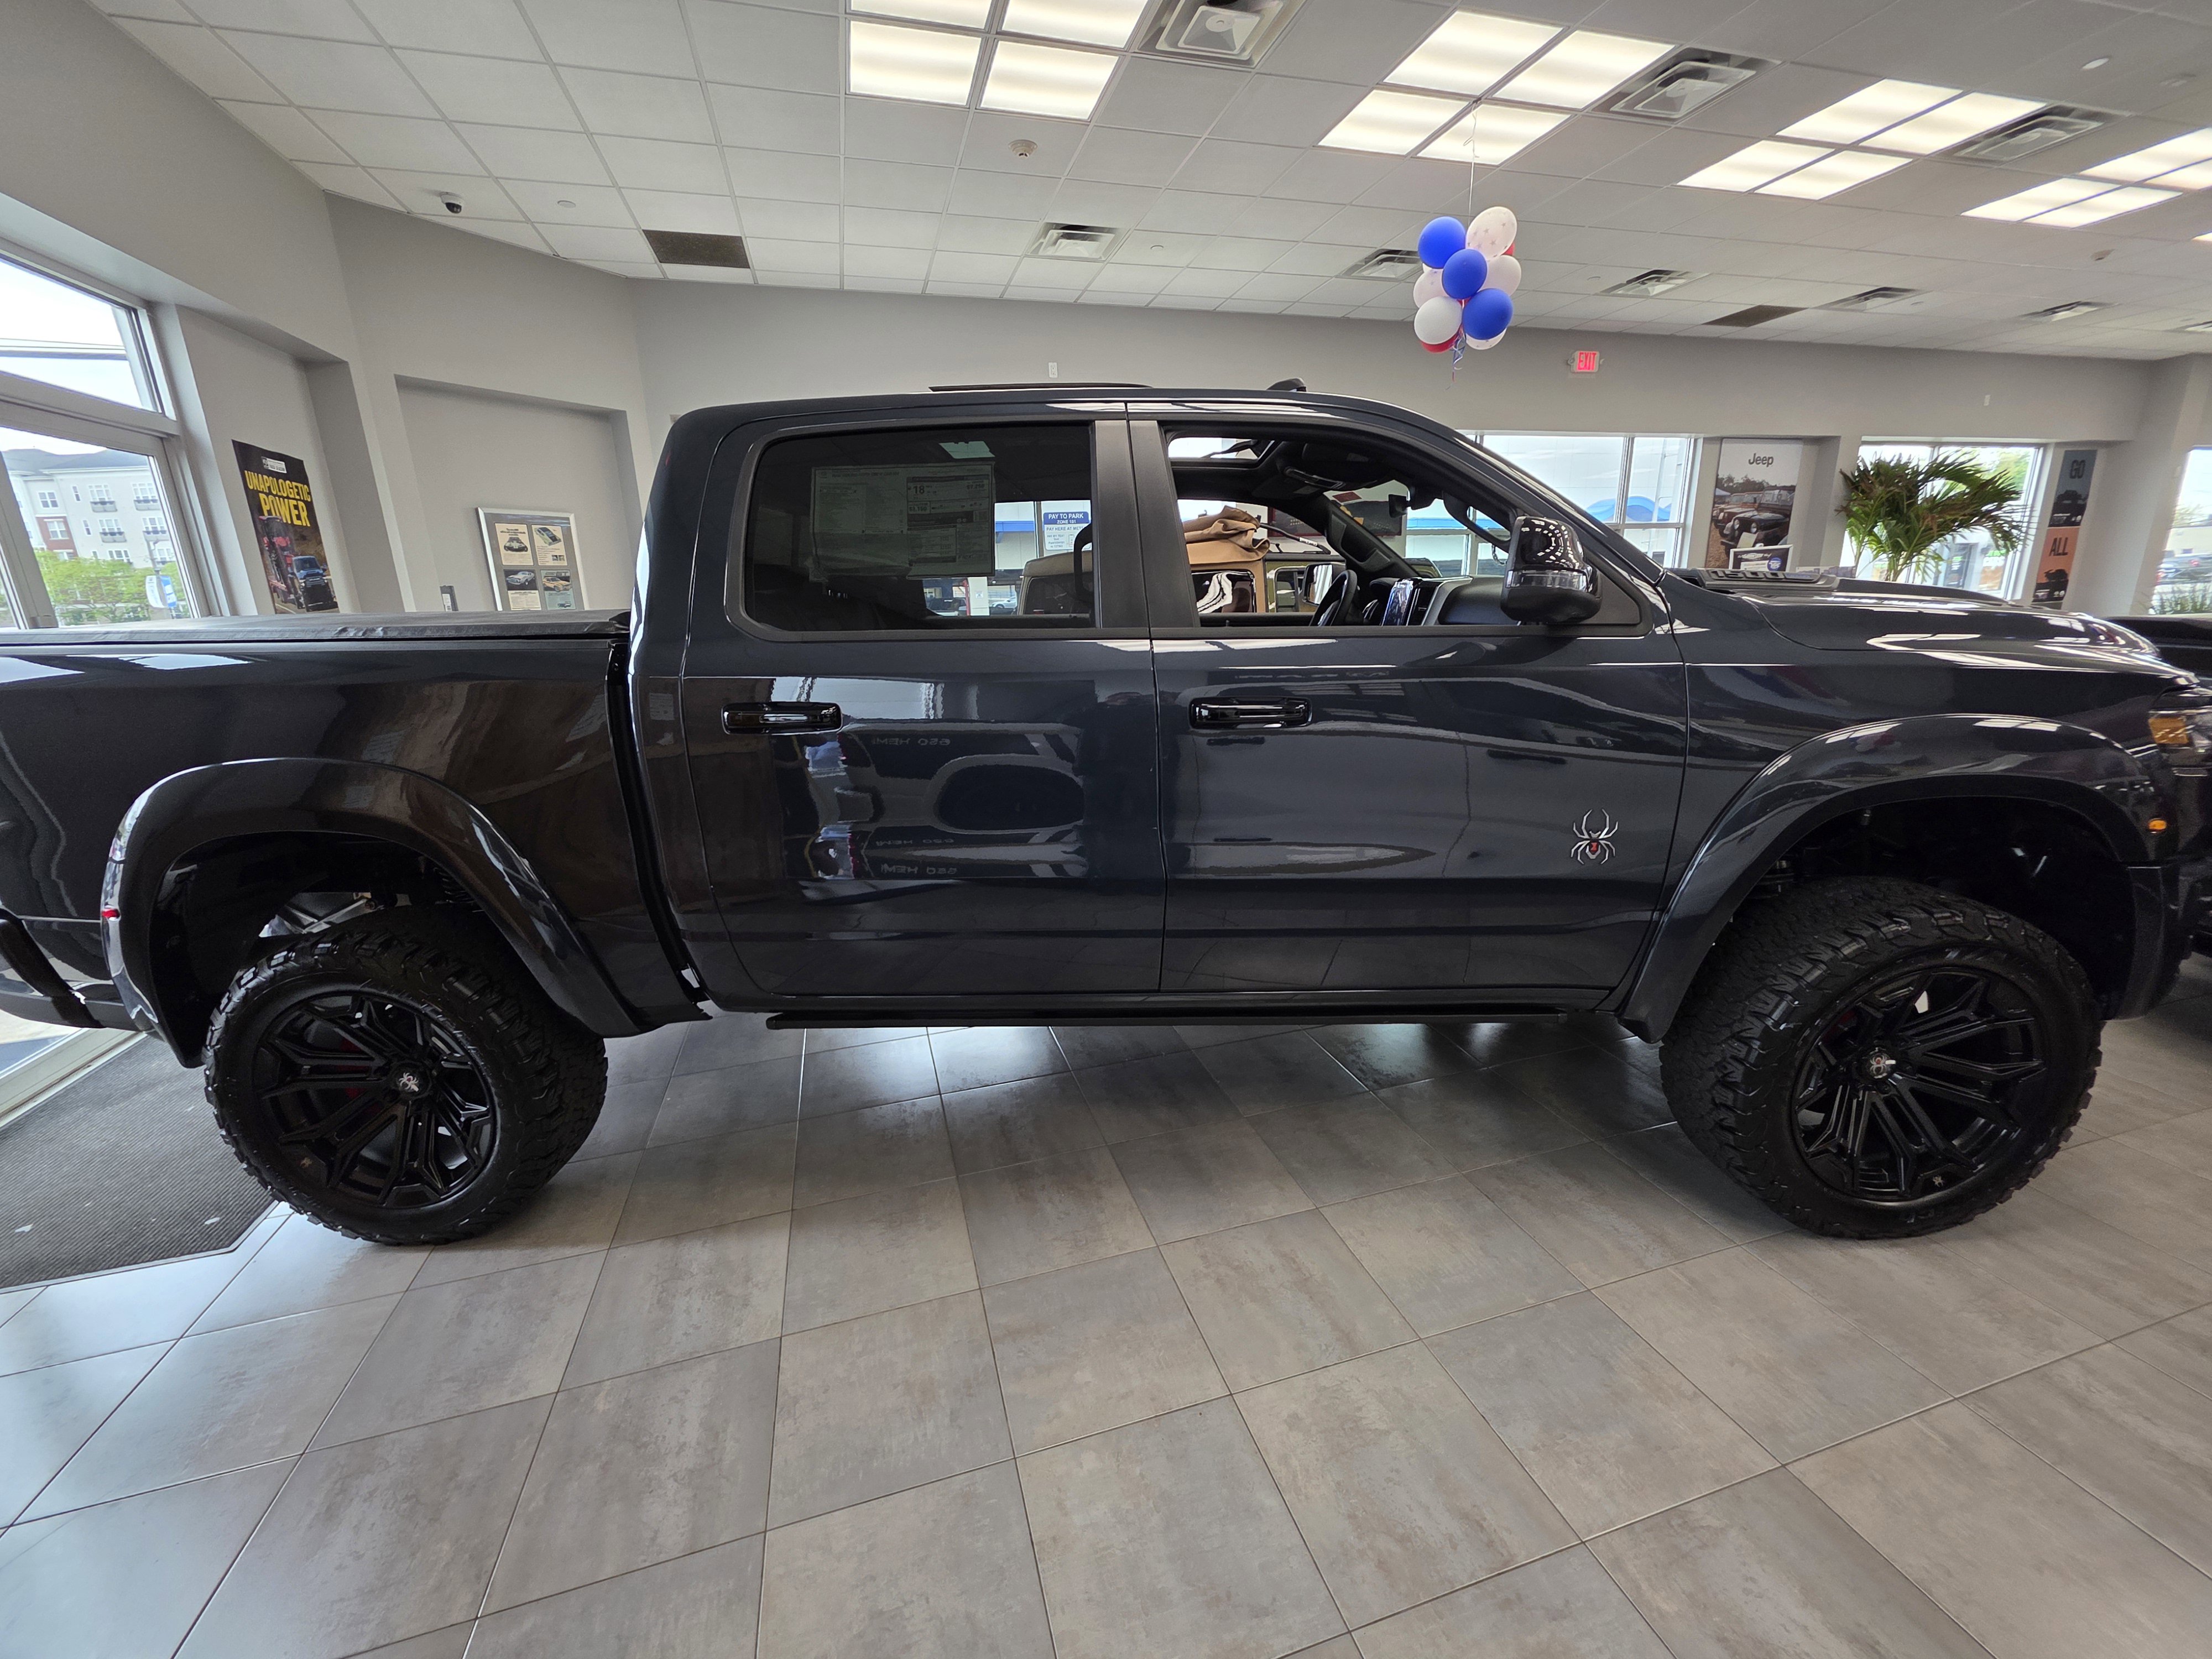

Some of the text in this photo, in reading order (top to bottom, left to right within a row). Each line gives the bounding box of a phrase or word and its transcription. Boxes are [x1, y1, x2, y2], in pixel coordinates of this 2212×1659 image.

[1578, 352, 1597, 371] EXIT
[1748, 453, 1774, 467] Jeep
[2069, 460, 2085, 479] GO
[244, 470, 311, 502] UNAPOLOGETIC
[913, 486, 925, 494] 18
[259, 493, 310, 526] POWER
[2049, 537, 2068, 556] ALL
[1711, 570, 1785, 580] 1500
